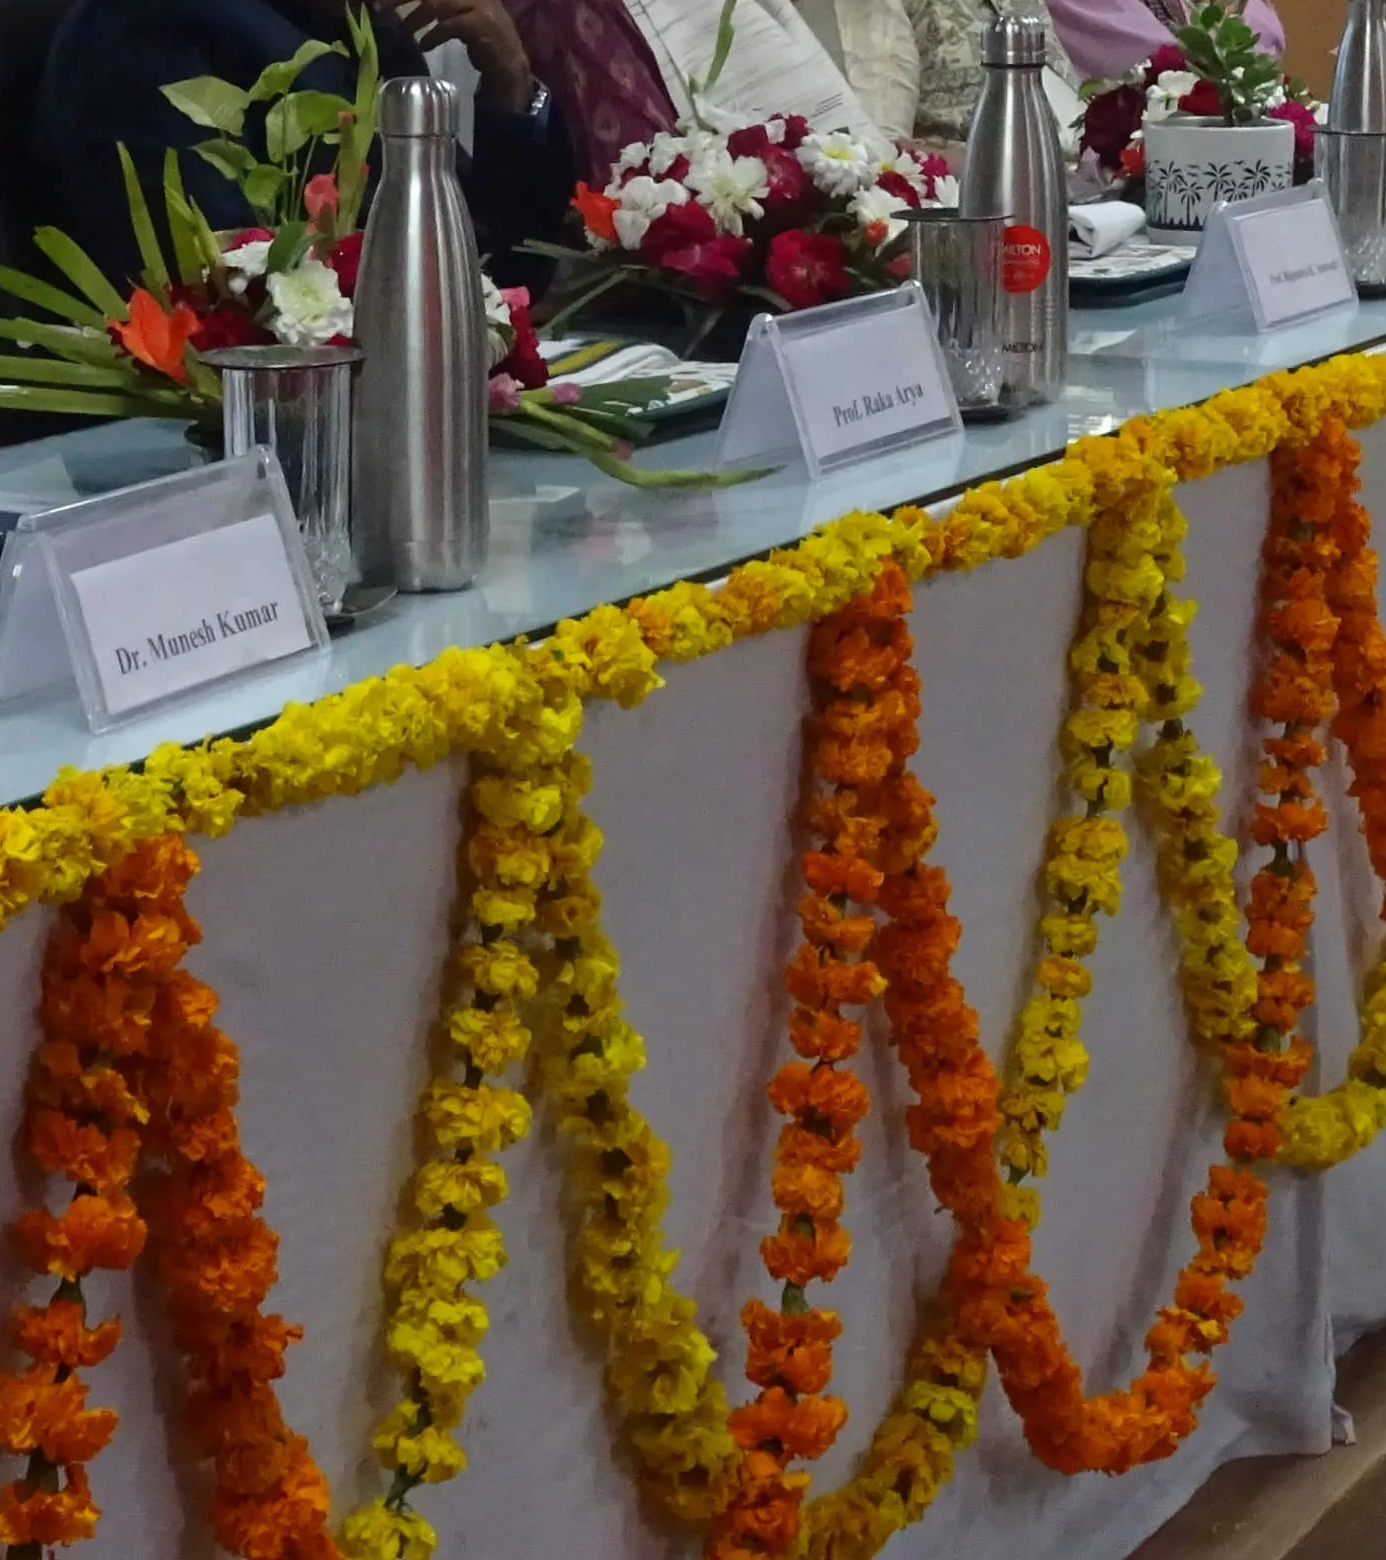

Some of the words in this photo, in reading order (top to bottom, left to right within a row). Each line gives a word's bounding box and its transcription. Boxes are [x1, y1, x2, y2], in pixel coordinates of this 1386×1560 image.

[832, 402, 863, 428] Prof.
[863, 389, 894, 415] Raka
[895, 382, 925, 409] Arya
[115, 646, 147, 676] Dr.
[148, 617, 216, 665] Munesh
[216, 600, 279, 638] Kumar
